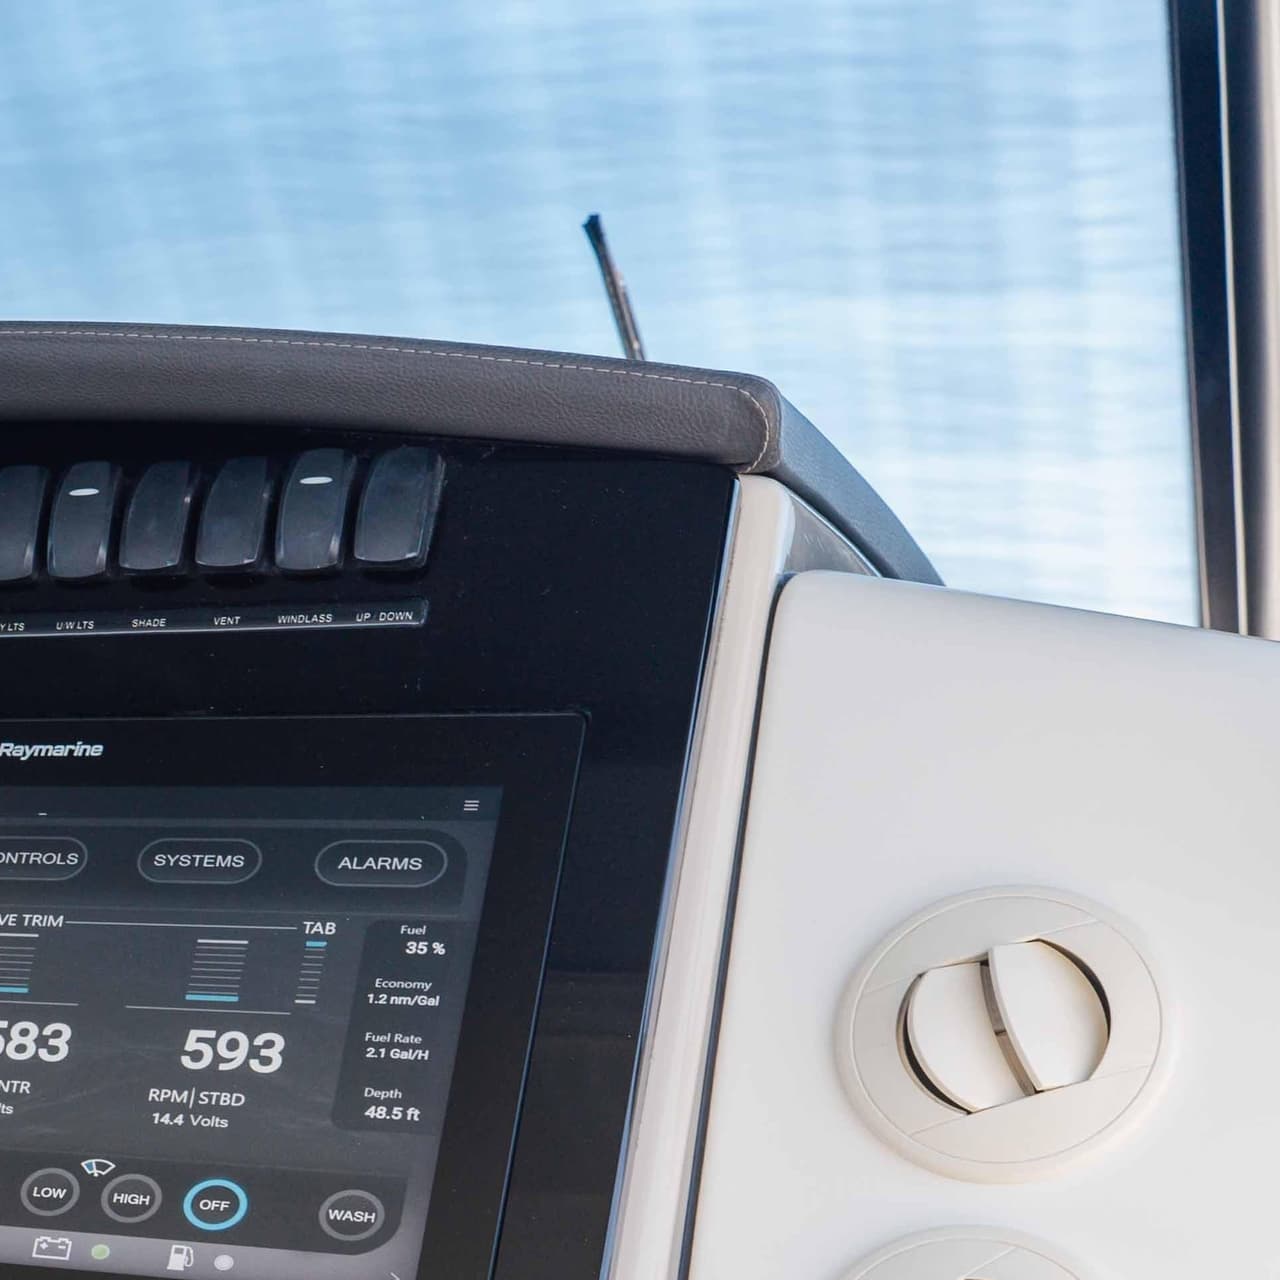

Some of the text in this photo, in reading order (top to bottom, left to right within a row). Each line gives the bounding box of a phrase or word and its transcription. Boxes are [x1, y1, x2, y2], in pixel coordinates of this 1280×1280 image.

[131, 617, 167, 628] SHADE
[213, 616, 241, 626] VENT
[277, 613, 333, 625] WINDLASS
[355, 610, 414, 622] UP DOWN
[7, 622, 25, 631] LTS
[76, 619, 95, 629] LTS
[153, 853, 245, 868] SYSTEMS
[337, 856, 424, 871] ALARMS
[21, 913, 64, 928] TRIM
[303, 921, 337, 936] TAB
[400, 924, 427, 936] Fuel
[405, 941, 446, 956] 35 %
[374, 977, 433, 992] Economy
[367, 993, 440, 1008] 1.2 nm/Gal
[365, 1031, 423, 1045] Fuel Rate
[179, 1028, 286, 1074] 593
[365, 1047, 430, 1061] 2.1 Gal/H
[364, 1087, 403, 1102] Depth
[152, 1112, 229, 1128] 14.4 Volts
[363, 1105, 421, 1122] 48.5 ft
[32, 1186, 67, 1200] LOW
[112, 1192, 151, 1207] HIGH
[199, 1199, 230, 1213] OFF
[328, 1209, 376, 1225] WASH
